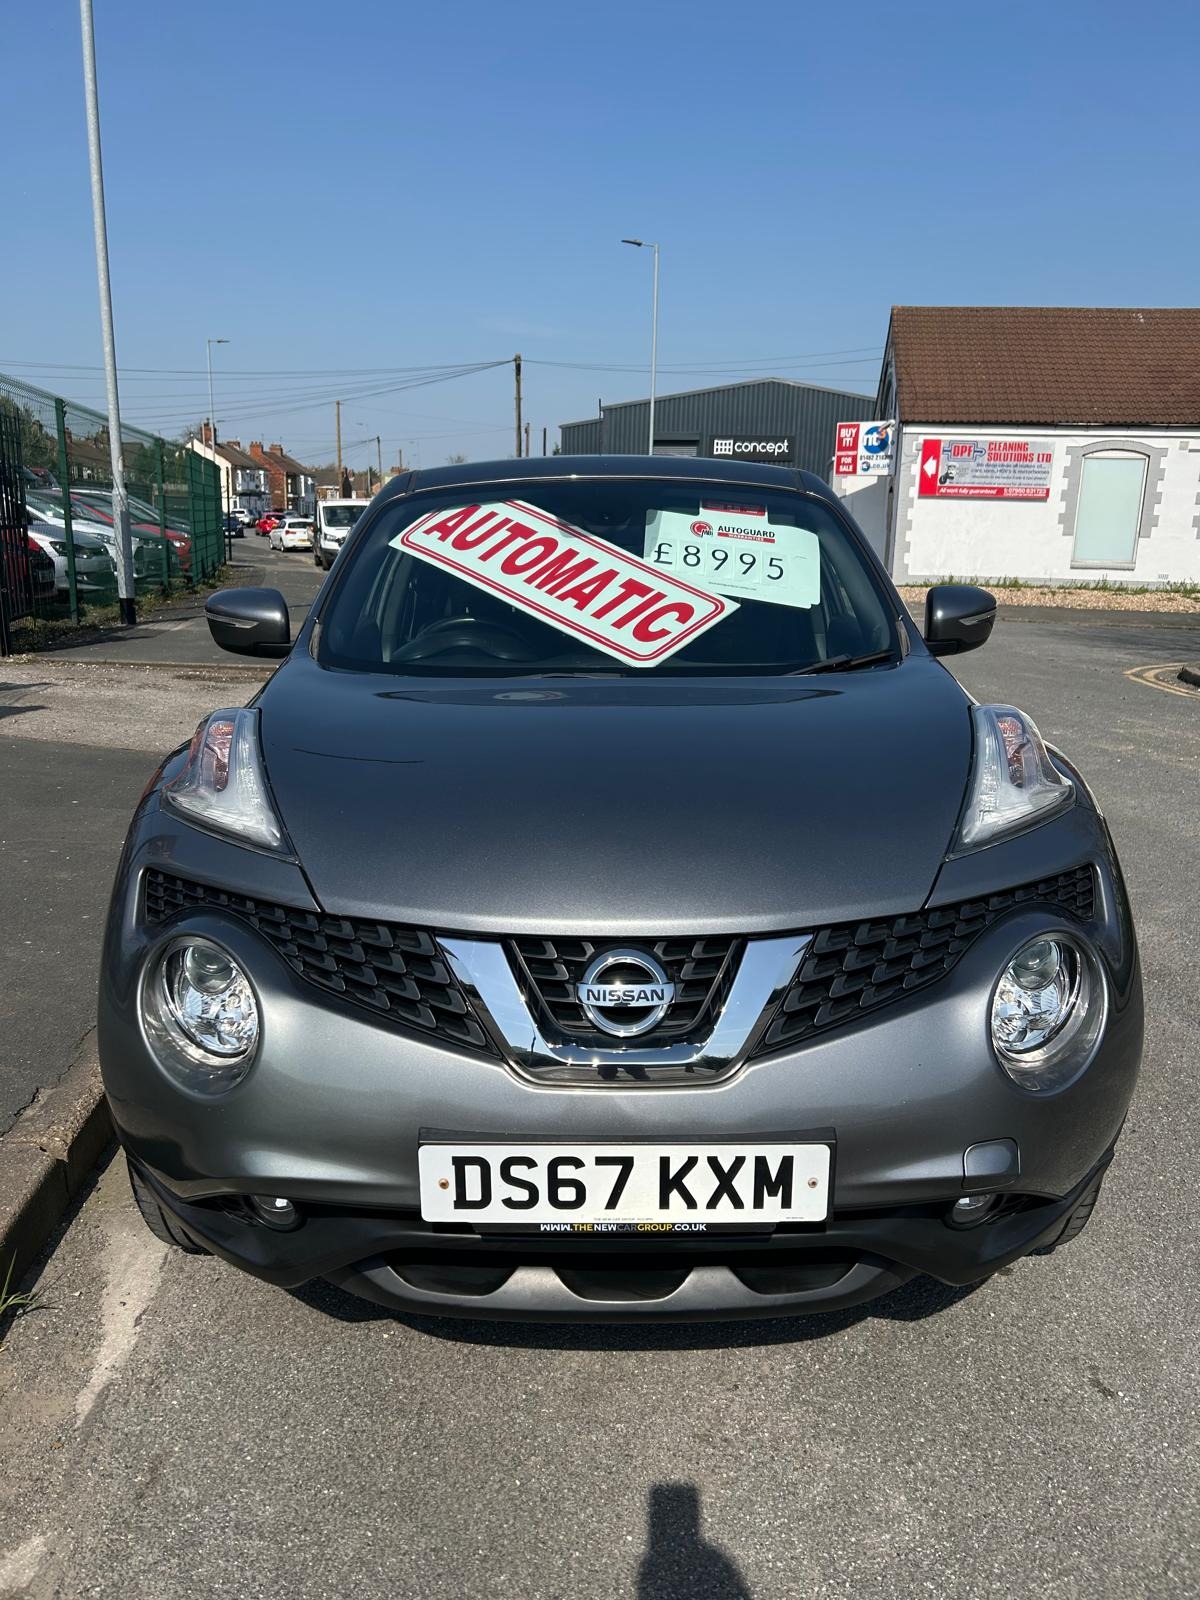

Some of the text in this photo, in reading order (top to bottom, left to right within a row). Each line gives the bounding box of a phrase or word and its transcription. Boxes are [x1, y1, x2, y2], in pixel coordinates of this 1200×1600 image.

[840, 428, 857, 438] BUY
[734, 440, 788, 456] concept
[988, 442, 1029, 452] CLEANING
[987, 452, 1052, 463] SOLUTIONS LTD
[718, 525, 775, 538] AUTOGUARD
[654, 542, 784, 580] £8995
[422, 504, 695, 642] AUTOMATIC
[586, 988, 664, 1002] NISSAN
[452, 1156, 794, 1210] DS67 KXM
